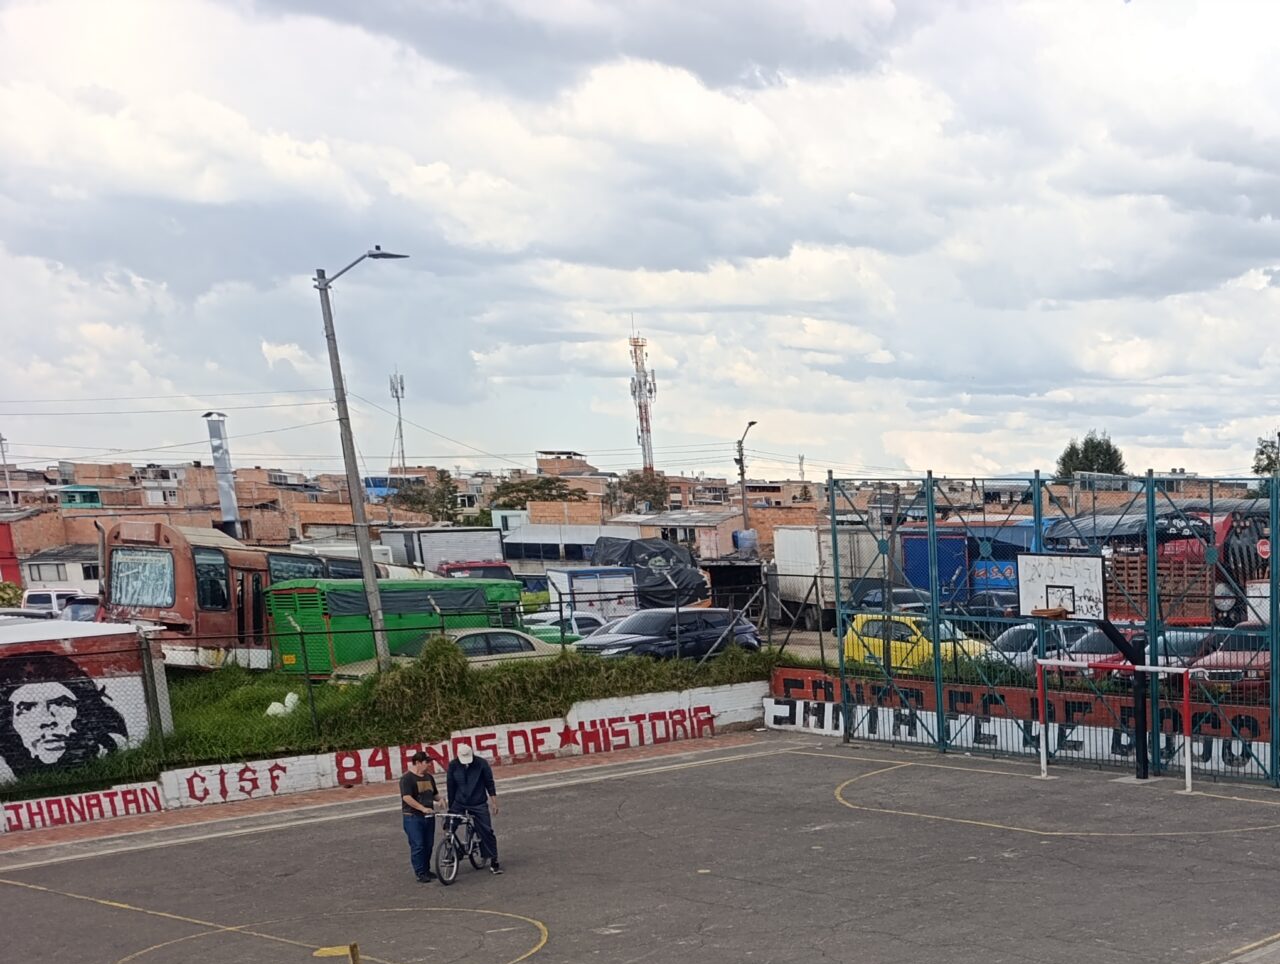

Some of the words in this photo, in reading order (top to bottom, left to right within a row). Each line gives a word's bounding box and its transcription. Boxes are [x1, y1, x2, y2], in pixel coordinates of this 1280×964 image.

[773, 678, 924, 738] SANTA
[335, 745, 392, 786] 84
[507, 726, 556, 763] DE
[578, 705, 715, 754] HISTORIA
[4, 786, 162, 832] JHONATAN
